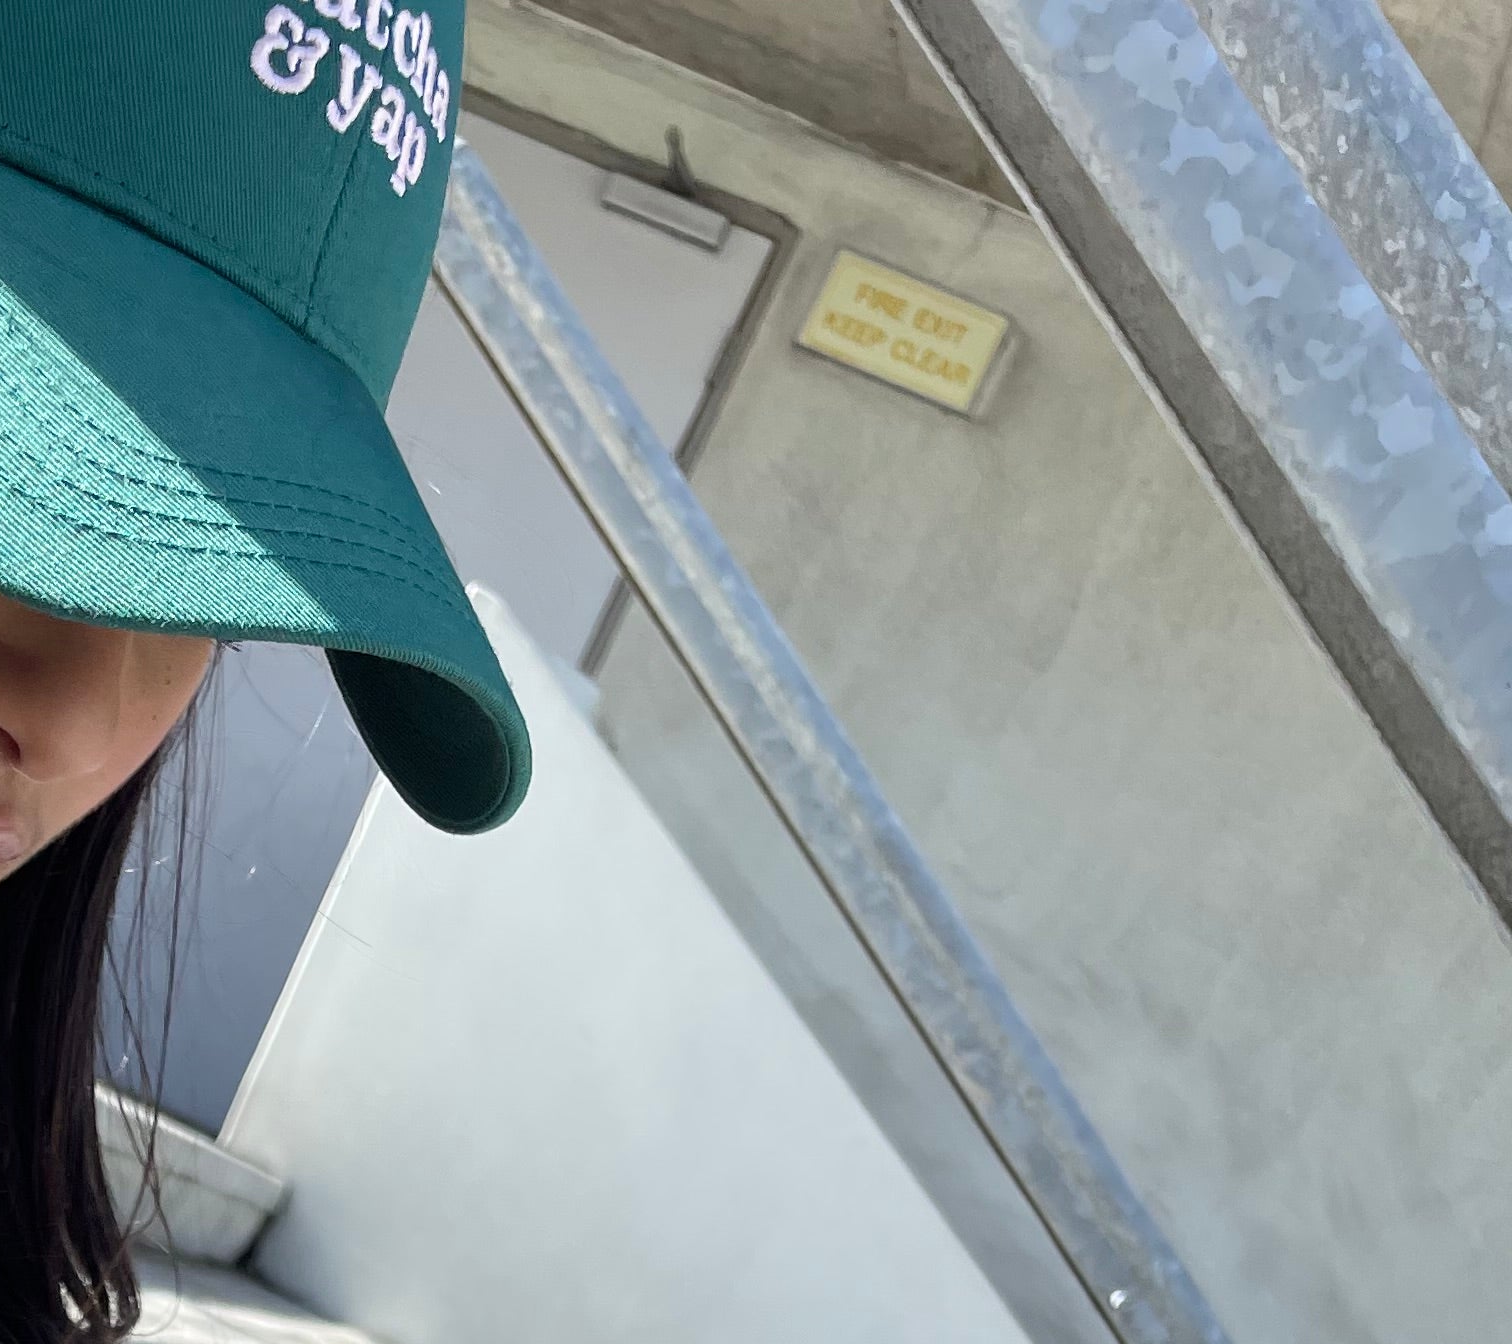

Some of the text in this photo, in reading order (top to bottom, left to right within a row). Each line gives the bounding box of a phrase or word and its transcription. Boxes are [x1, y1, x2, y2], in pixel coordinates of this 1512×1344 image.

[299, 0, 449, 143] tcha
[823, 310, 971, 385] KEEP CLEAR
[855, 282, 969, 344] FIRE EXIT
